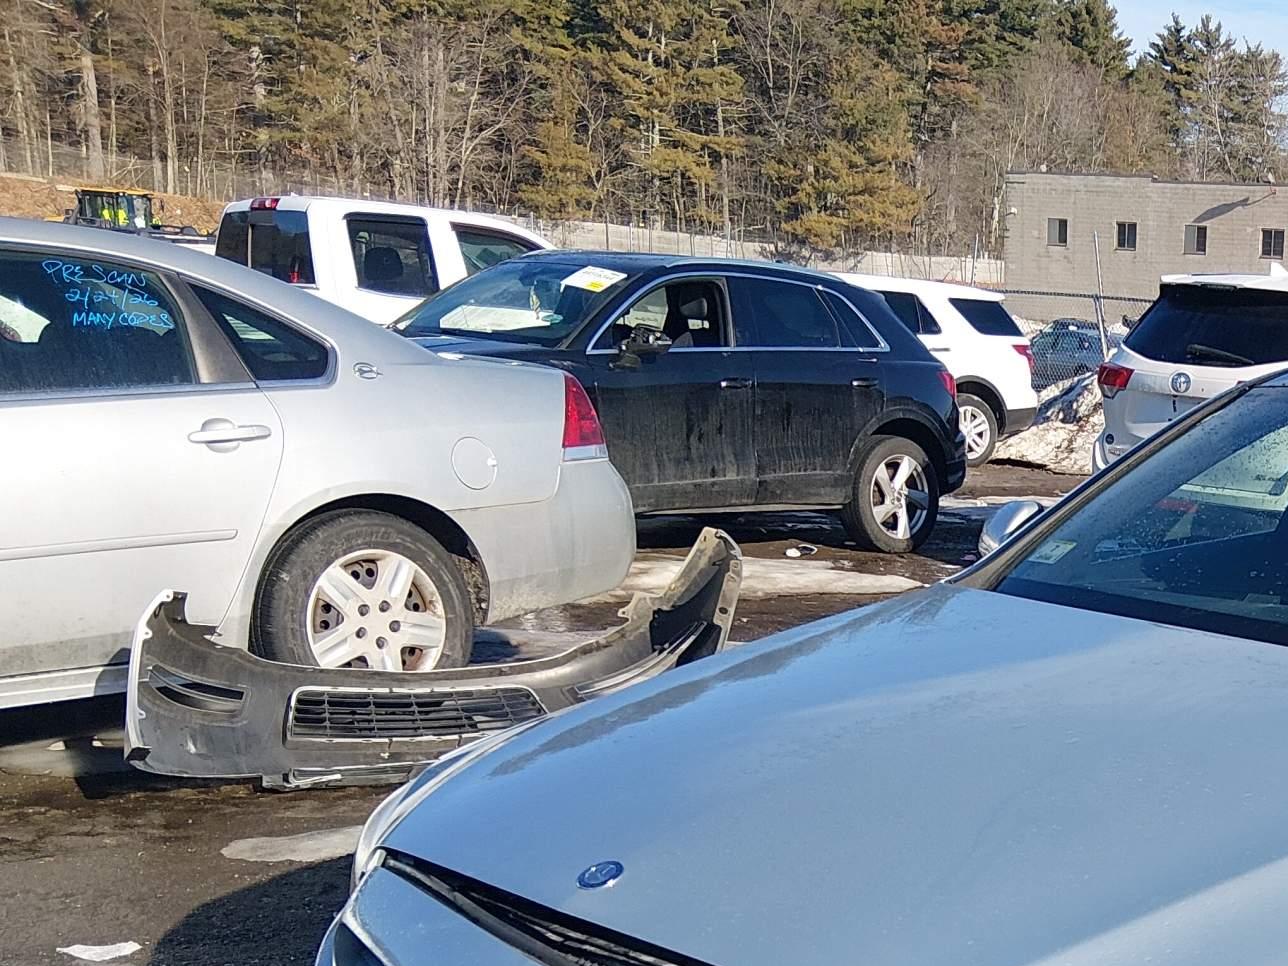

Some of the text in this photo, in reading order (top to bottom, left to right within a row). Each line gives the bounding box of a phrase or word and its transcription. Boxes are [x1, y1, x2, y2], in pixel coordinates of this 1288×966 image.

[65, 287, 158, 310] 2/24/26
[73, 311, 175, 330] MANY CODES
